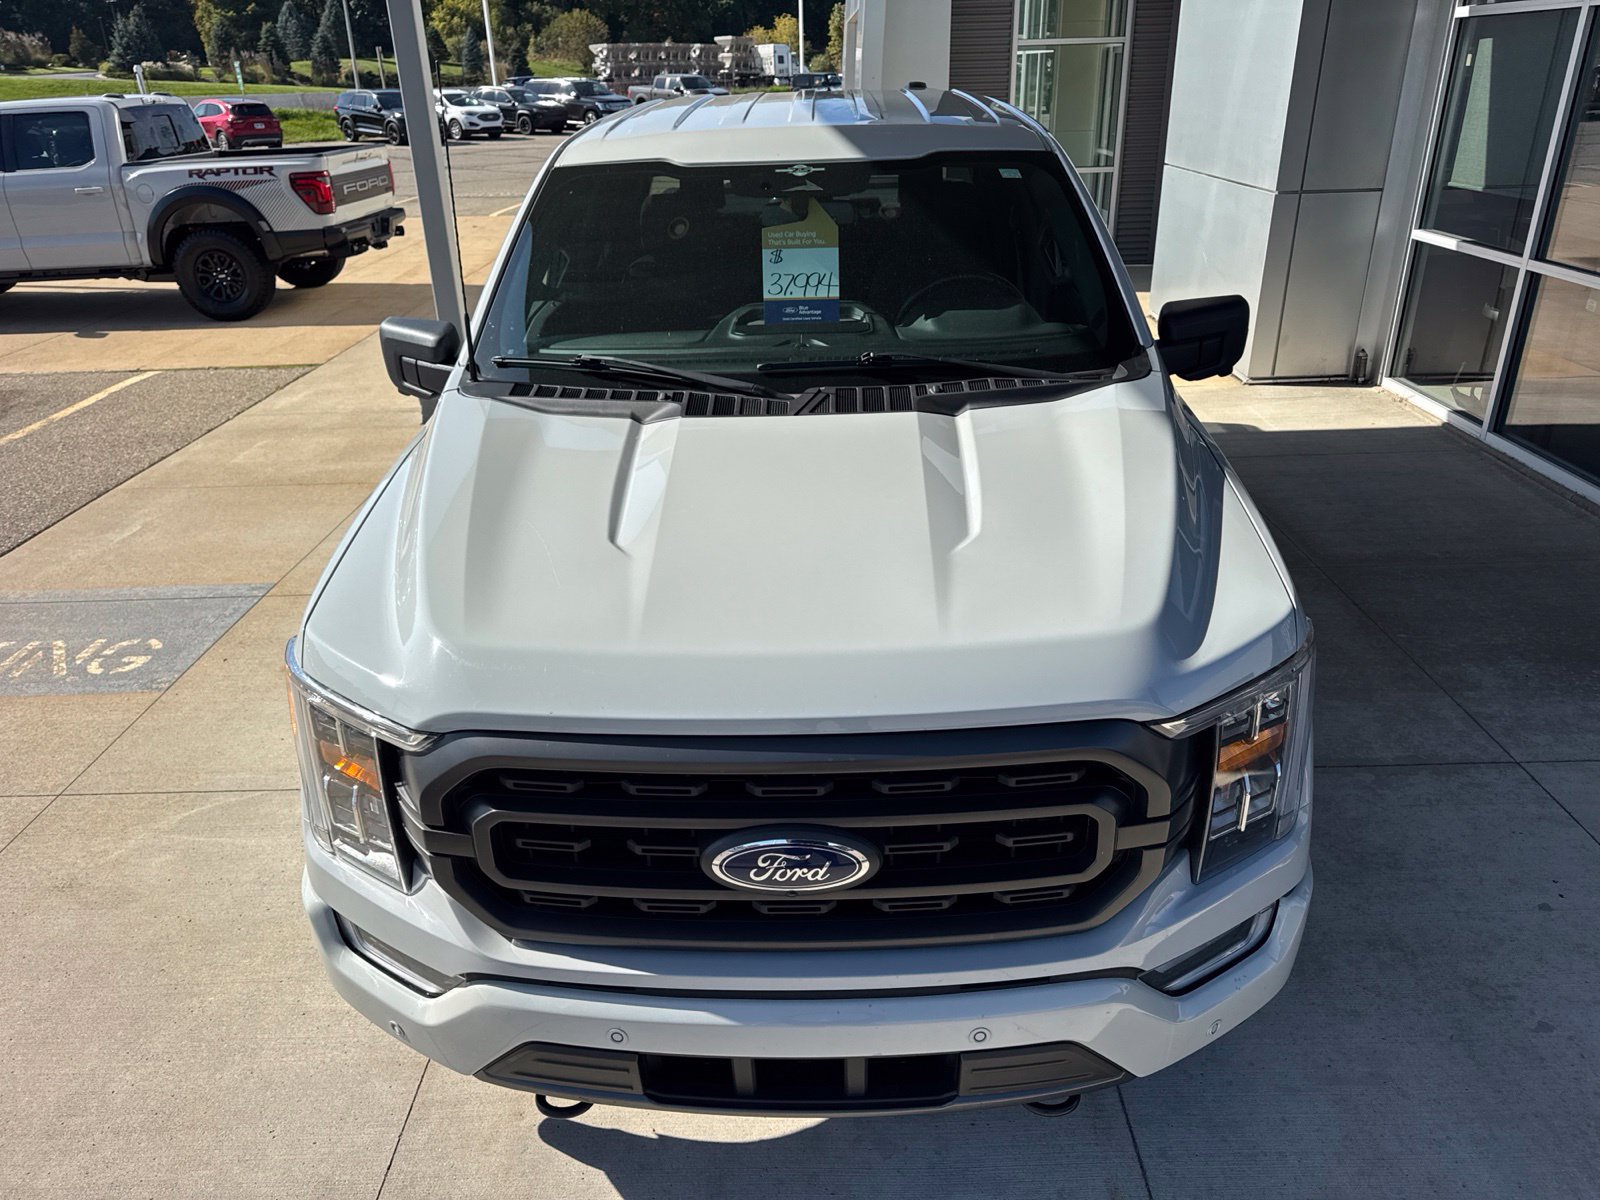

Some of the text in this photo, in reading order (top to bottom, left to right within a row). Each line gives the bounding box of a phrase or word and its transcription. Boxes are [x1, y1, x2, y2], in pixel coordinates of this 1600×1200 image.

[188, 165, 278, 181] RAPTOR
[342, 175, 389, 196] FORD
[795, 231, 817, 239] Buying
[769, 249, 783, 264] $
[750, 853, 832, 882] Ford
